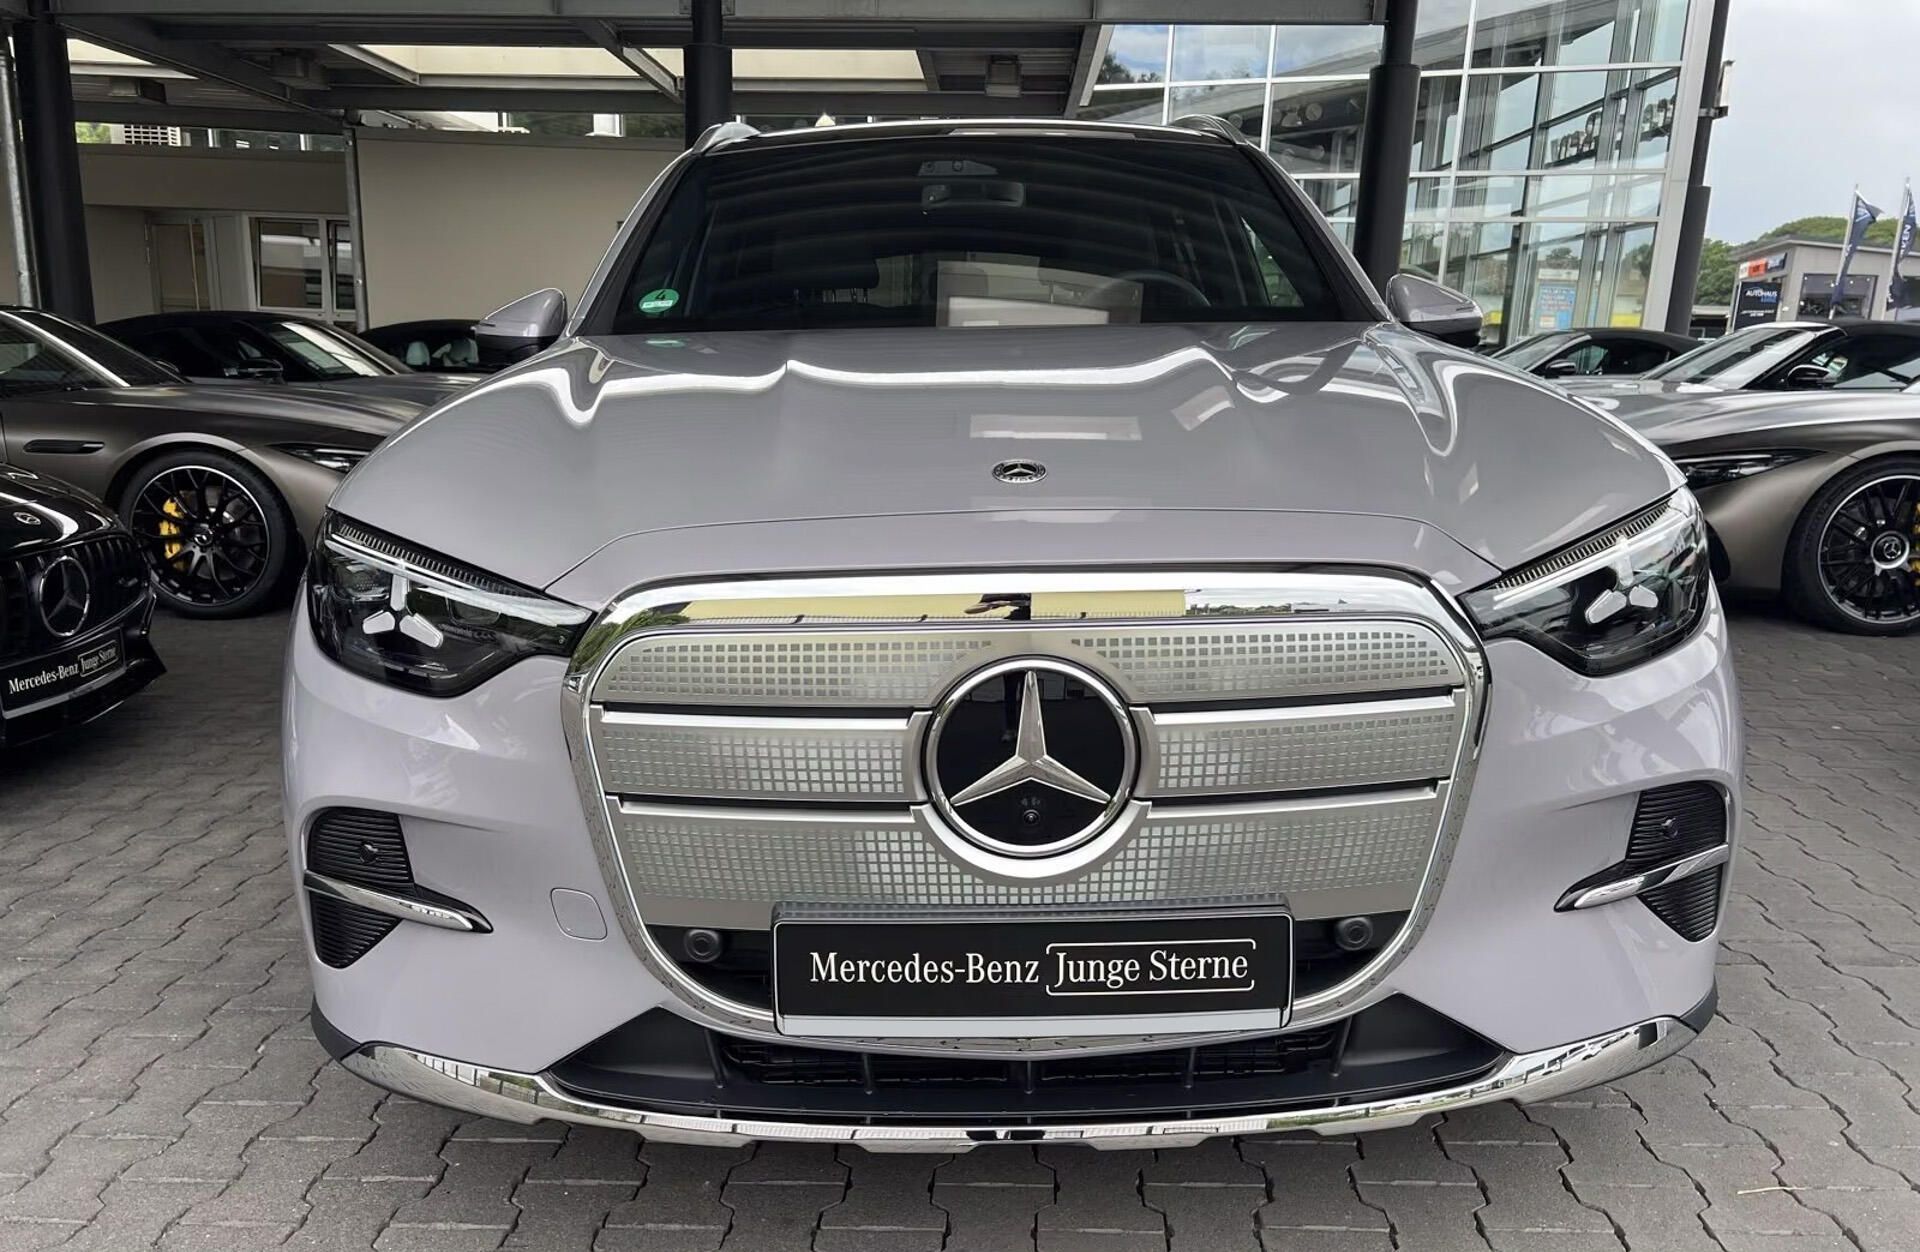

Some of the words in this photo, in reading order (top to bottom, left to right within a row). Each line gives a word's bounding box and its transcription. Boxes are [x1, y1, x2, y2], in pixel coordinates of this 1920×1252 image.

[655, 289, 666, 300] 4
[1746, 289, 1778, 297] AUTOHAUS
[8, 663, 79, 694] Mercedes-Benz
[810, 952, 1038, 983] Mercedes-Benz
[1055, 953, 1139, 988] Junge
[1149, 949, 1249, 982] Sterne
